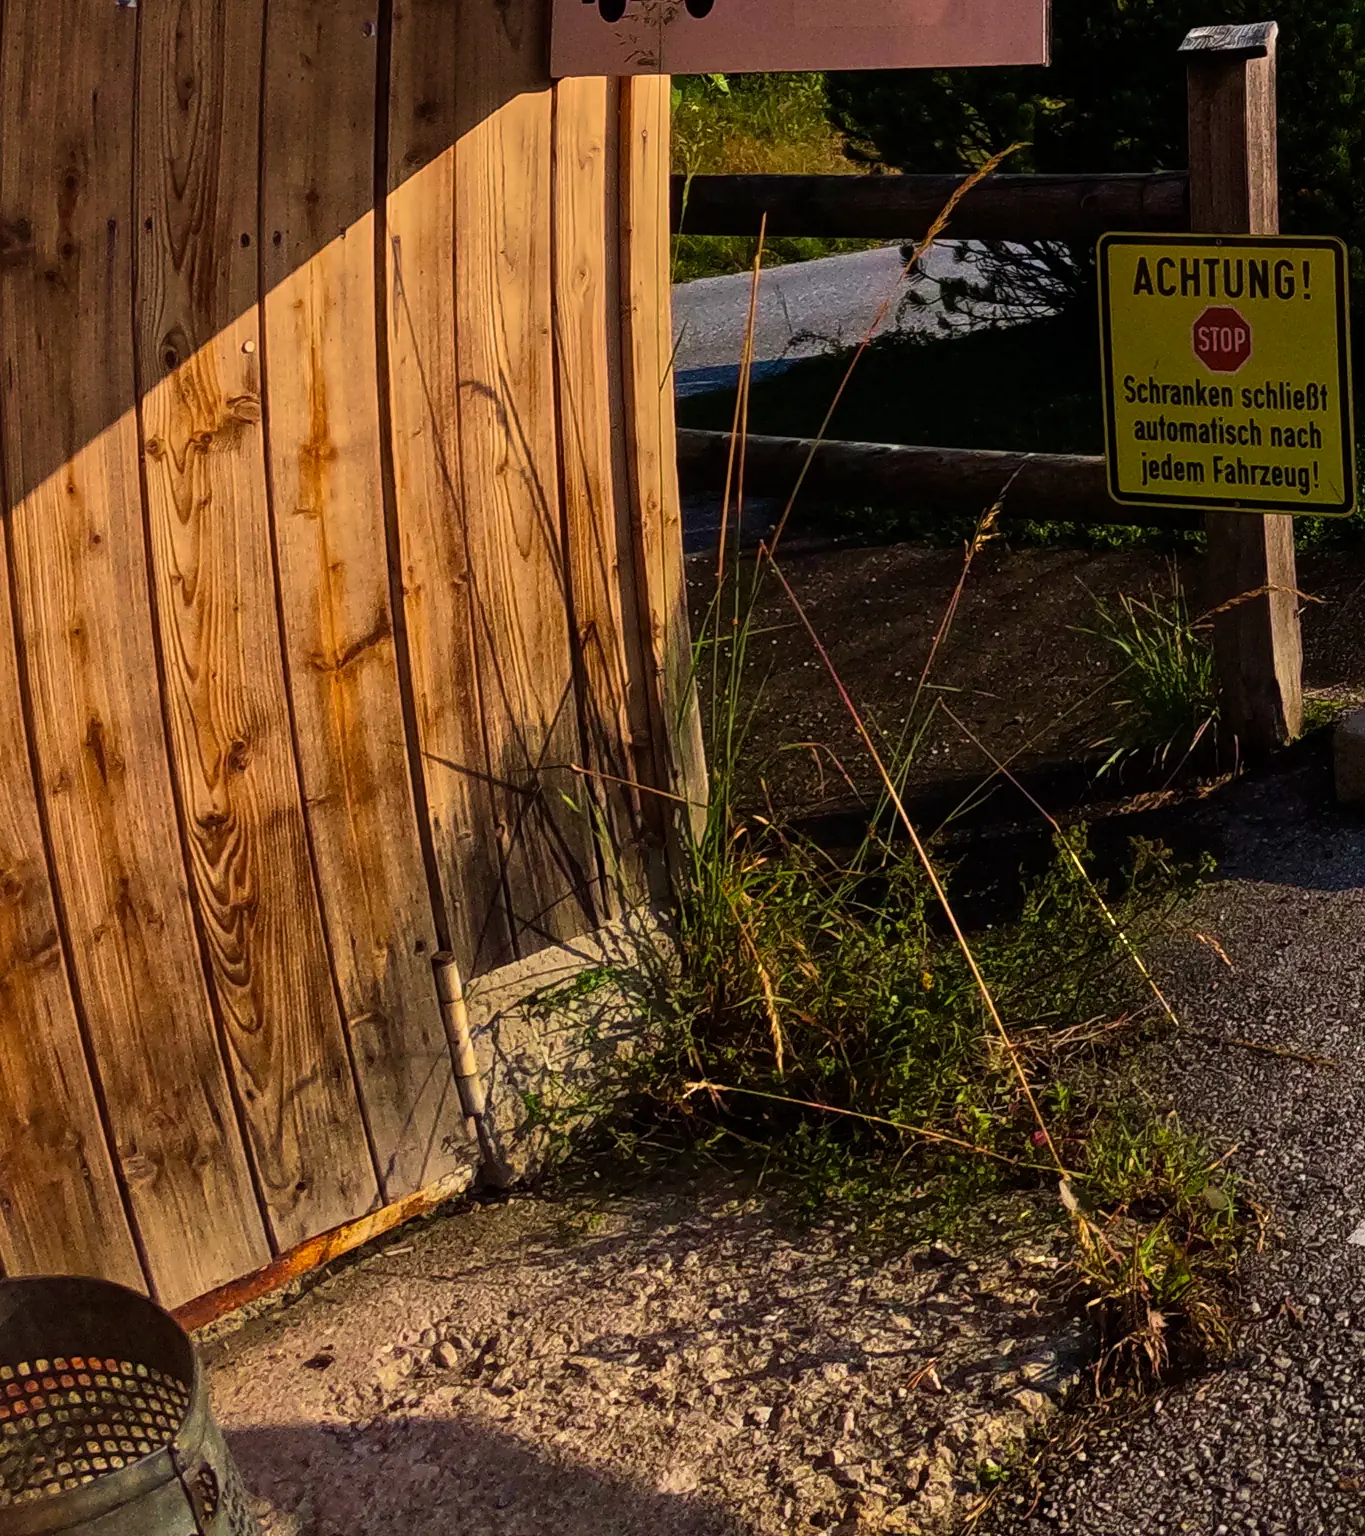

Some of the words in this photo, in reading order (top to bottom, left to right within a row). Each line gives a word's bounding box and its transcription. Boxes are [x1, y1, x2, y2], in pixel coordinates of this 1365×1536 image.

[1133, 257, 1312, 299] ACHTUNG!
[1198, 327, 1246, 353] STOP
[1123, 375, 1234, 408] Schranken
[1241, 381, 1328, 411] schließt
[1133, 417, 1262, 446] automatisch
[1270, 421, 1322, 449] nach
[1141, 452, 1205, 485] jedem
[1213, 455, 1320, 495] Fahrzeug!
